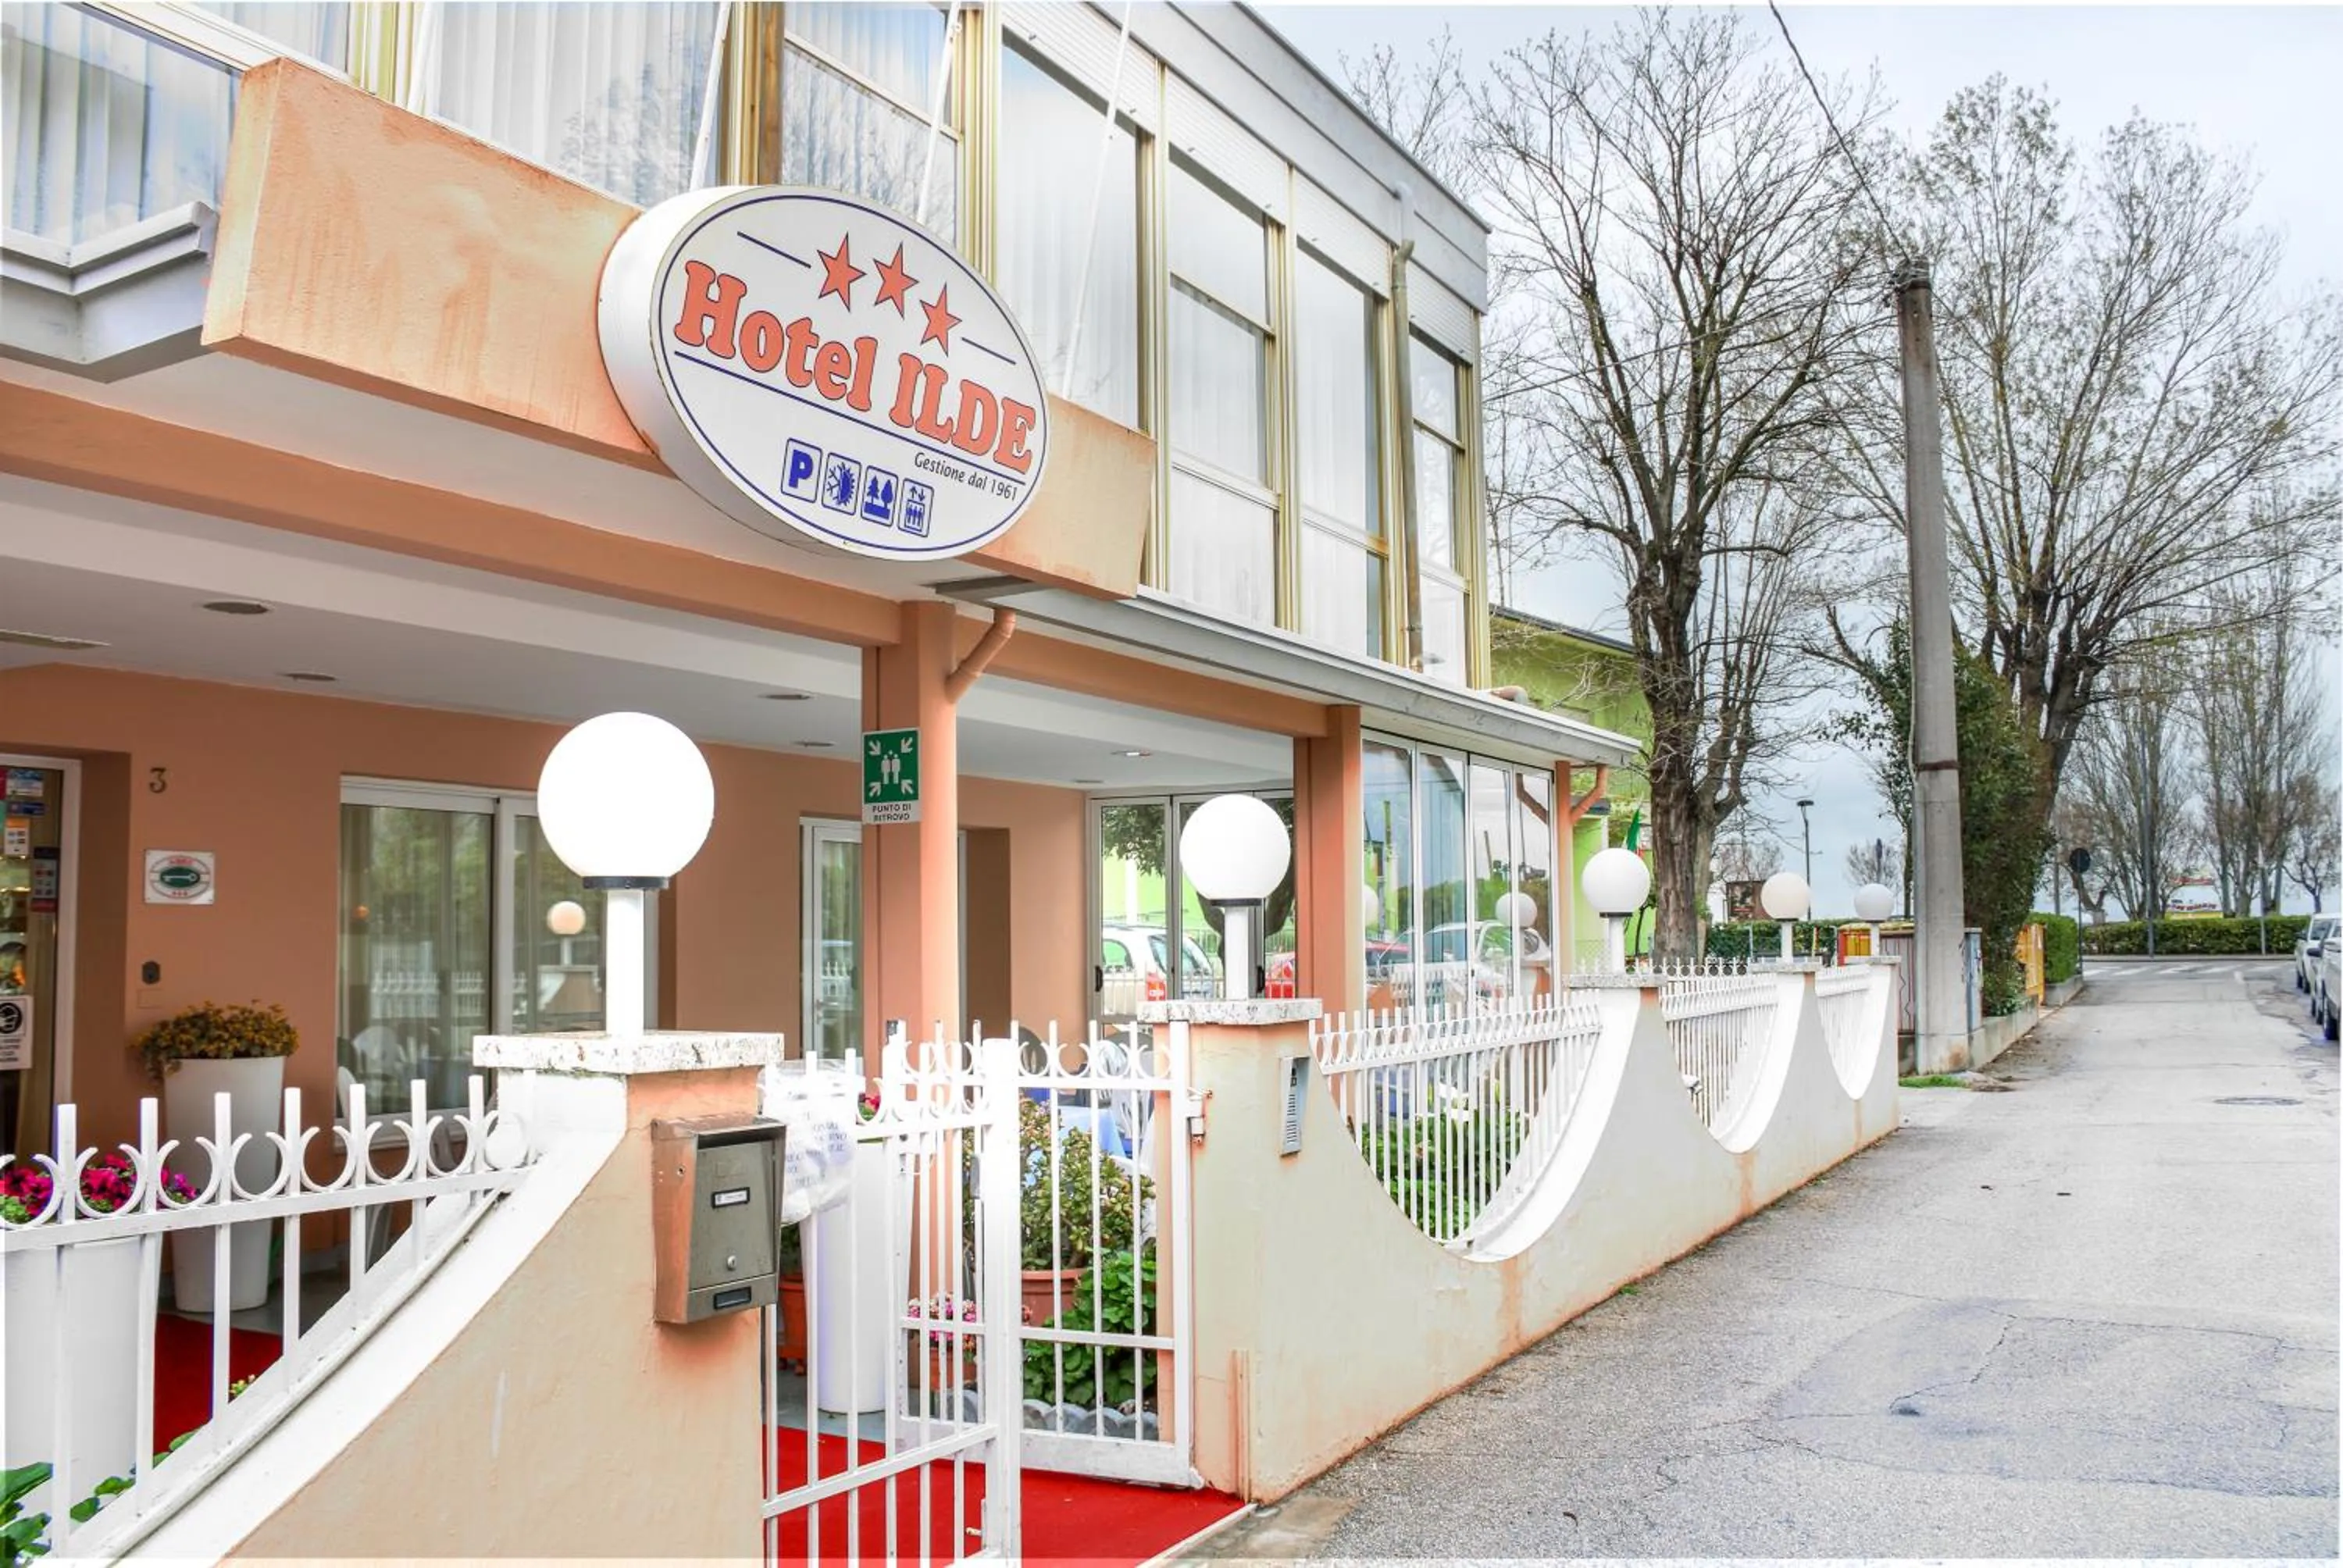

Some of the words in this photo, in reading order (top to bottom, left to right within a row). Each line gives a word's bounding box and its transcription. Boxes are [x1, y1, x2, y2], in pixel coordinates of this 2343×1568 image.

[673, 260, 879, 412] Hotel
[889, 352, 1036, 475] ILDE
[789, 449, 814, 488] P
[915, 452, 966, 483] Gestione
[968, 472, 988, 490] dal
[991, 479, 1018, 501] 1961
[149, 767, 166, 794] 3
